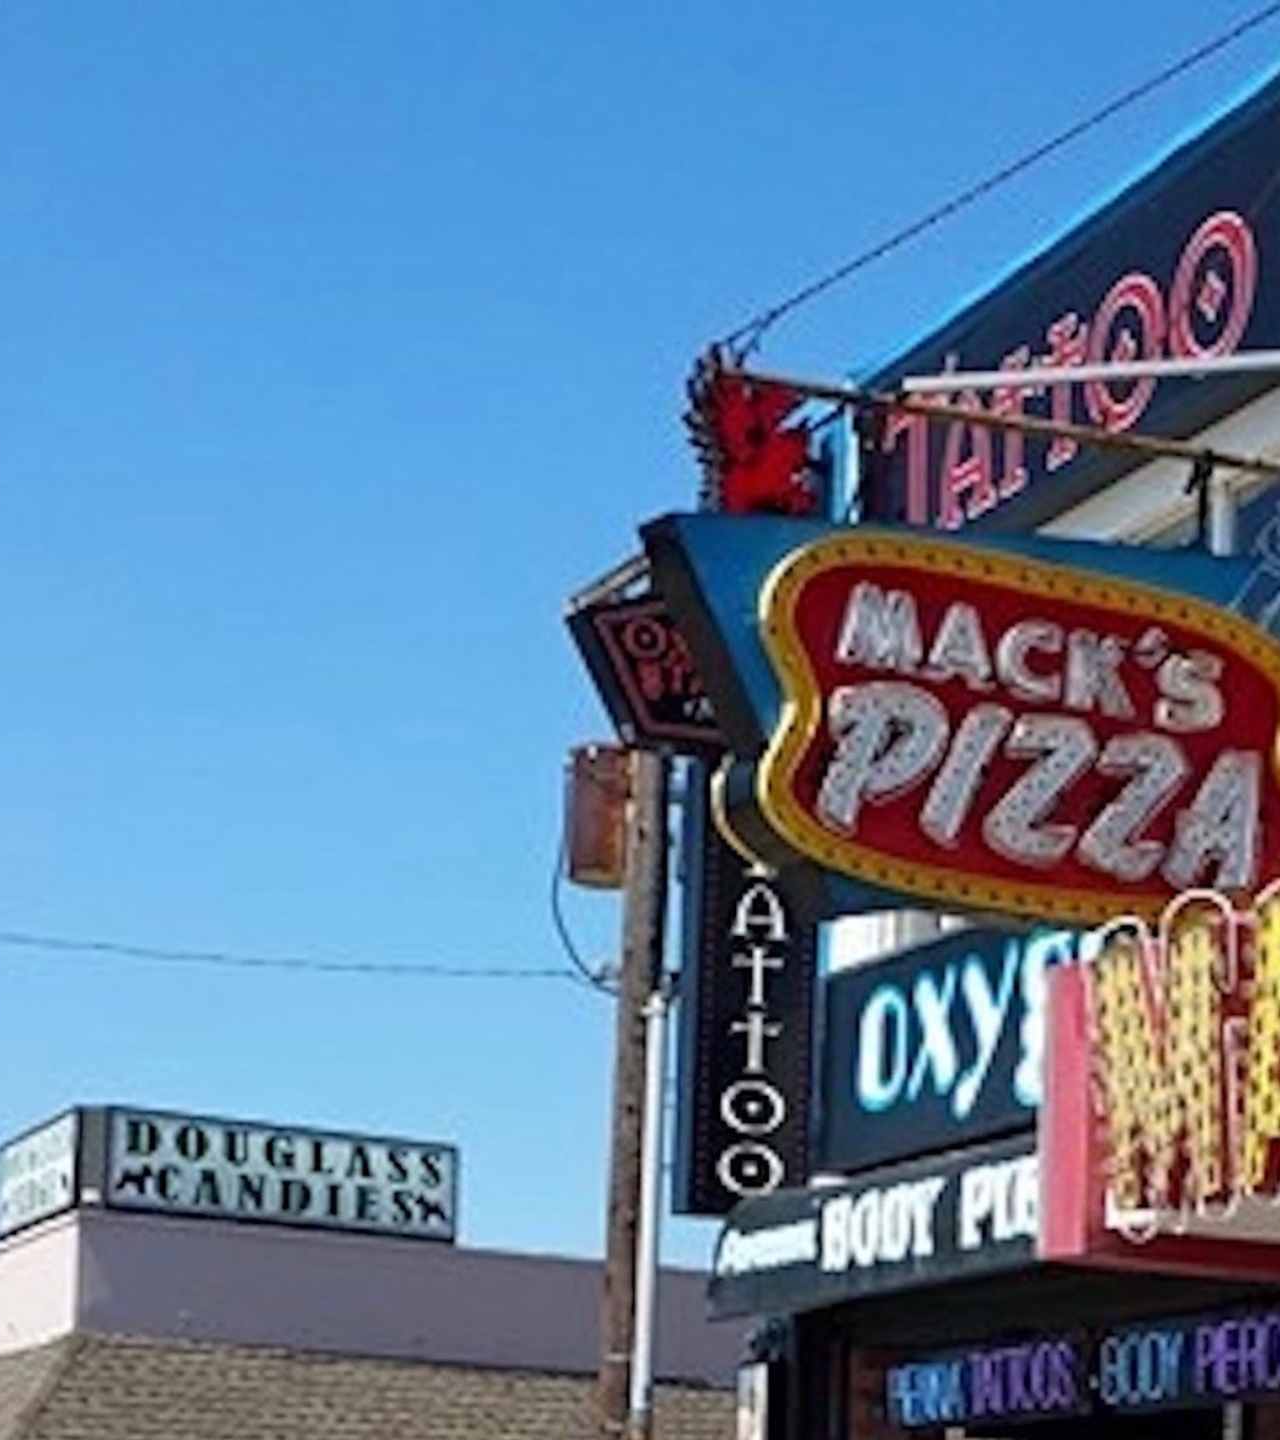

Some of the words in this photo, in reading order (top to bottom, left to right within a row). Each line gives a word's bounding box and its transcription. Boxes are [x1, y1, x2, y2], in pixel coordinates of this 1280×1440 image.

[878, 209, 1259, 531] TATTOO
[834, 580, 1225, 734] MACK'S
[817, 680, 1263, 893] PIZZA
[720, 864, 786, 1197] ATTOO
[126, 1119, 443, 1189] DOUGLASS
[154, 1163, 417, 1227] CANDIES
[821, 1176, 948, 1273] BODY
